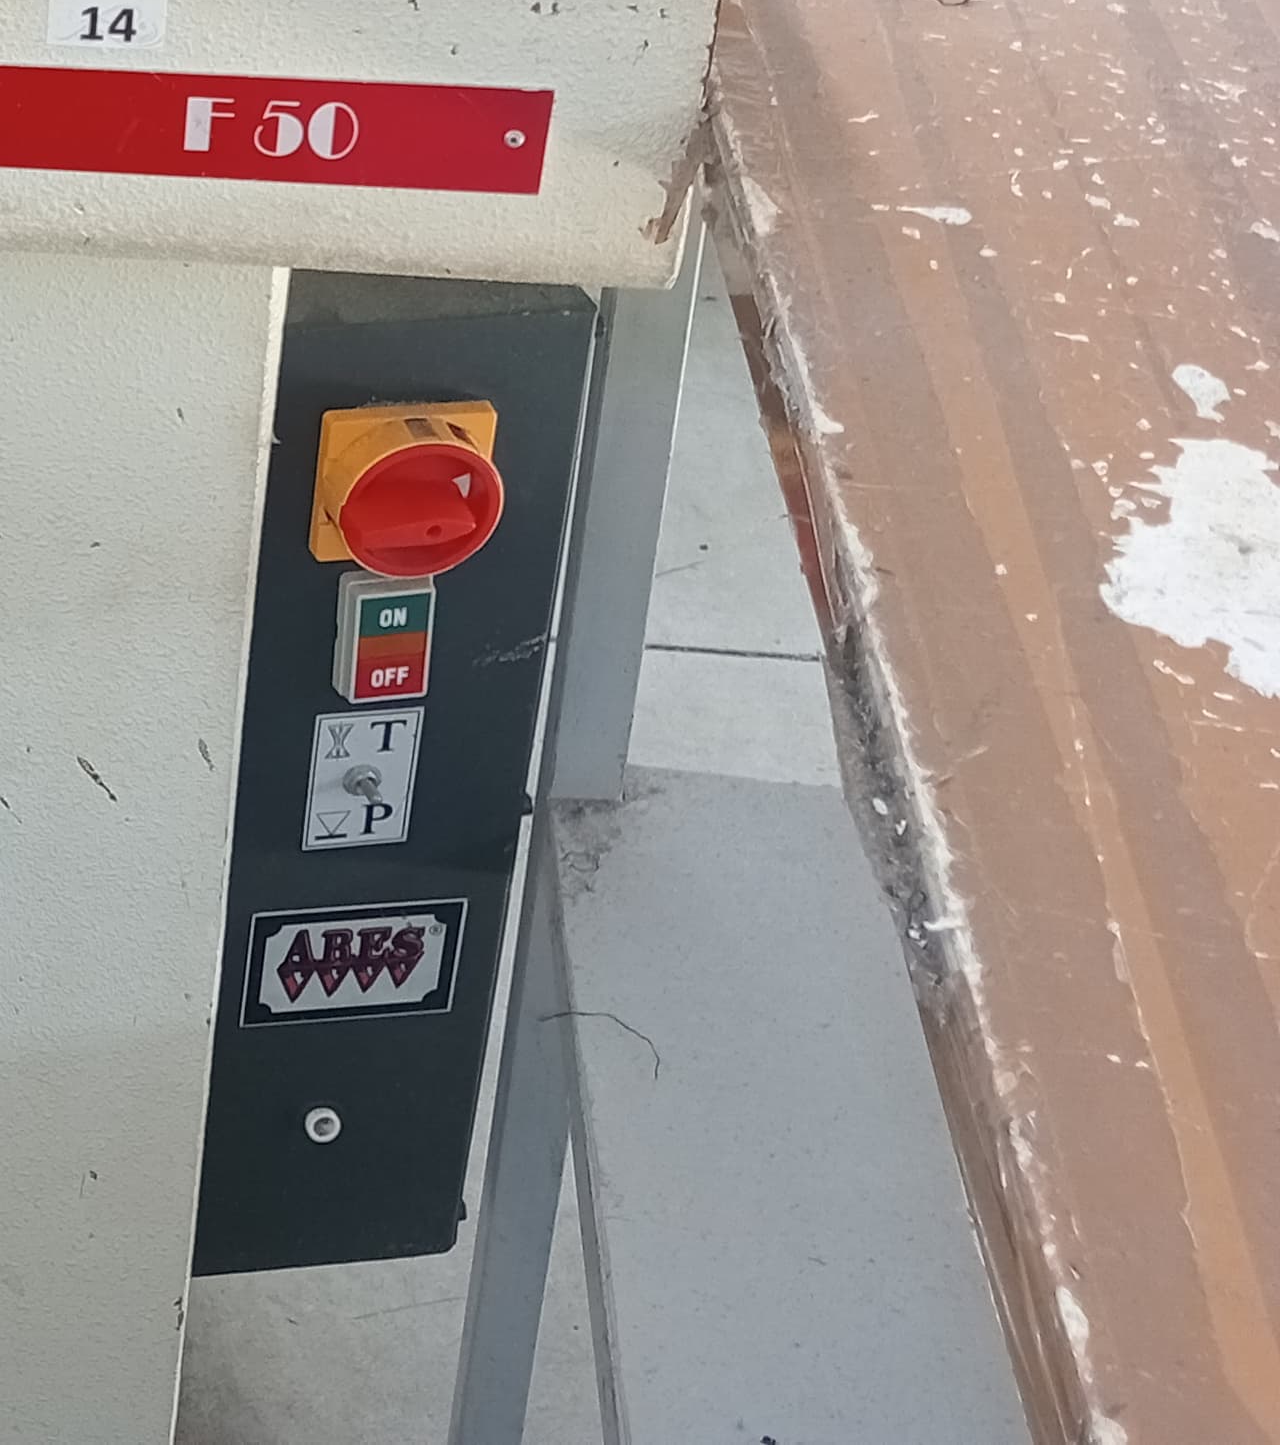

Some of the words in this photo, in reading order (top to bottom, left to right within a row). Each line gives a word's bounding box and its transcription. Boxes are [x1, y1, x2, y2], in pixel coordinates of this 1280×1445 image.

[80, 6, 137, 43] 14
[183, 96, 236, 152] F
[253, 100, 360, 160] 50
[378, 606, 408, 628] ON
[370, 665, 410, 688] OFF
[370, 719, 408, 753] T
[360, 802, 394, 836] P
[278, 926, 426, 971] ARES
